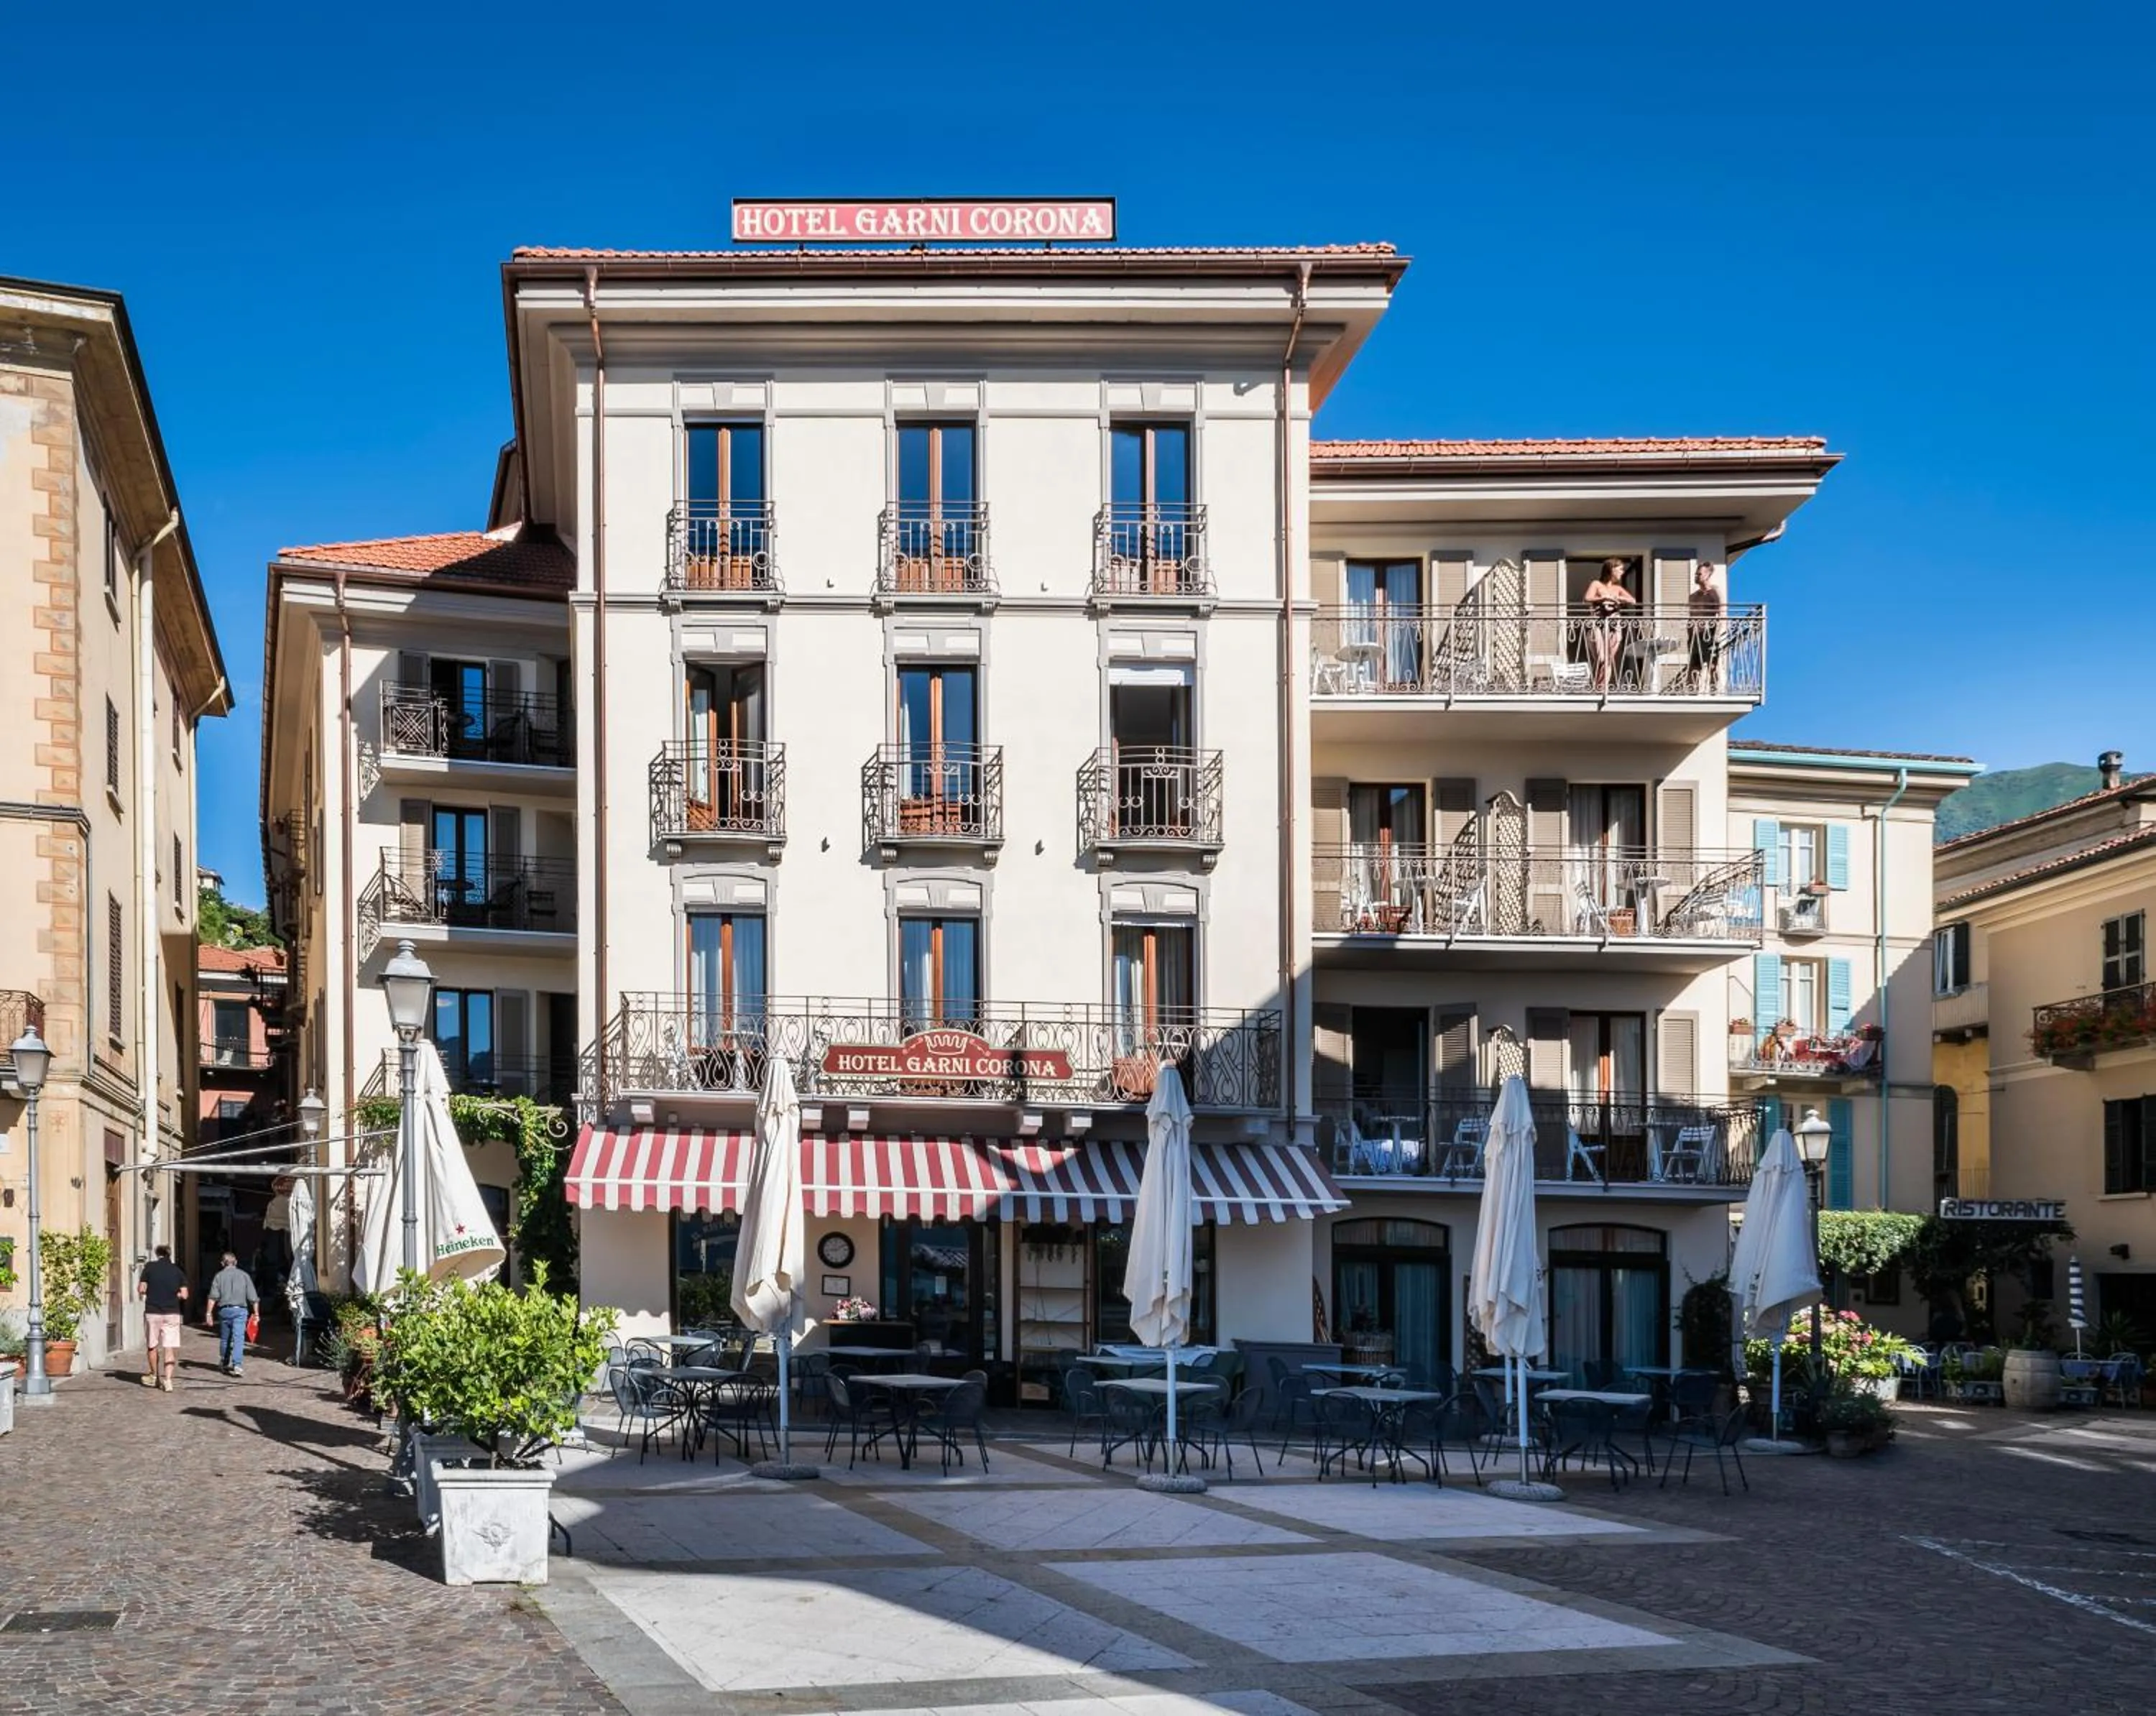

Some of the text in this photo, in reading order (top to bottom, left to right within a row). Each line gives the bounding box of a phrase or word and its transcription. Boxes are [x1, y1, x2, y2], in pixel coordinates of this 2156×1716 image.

[742, 207, 1105, 236] HOTEL GARNI CORONA
[838, 1054, 1057, 1077] HOTEL GARNI CORONA
[1943, 1199, 2066, 1218] RISTORANTE
[436, 1235, 494, 1256] Heineken
